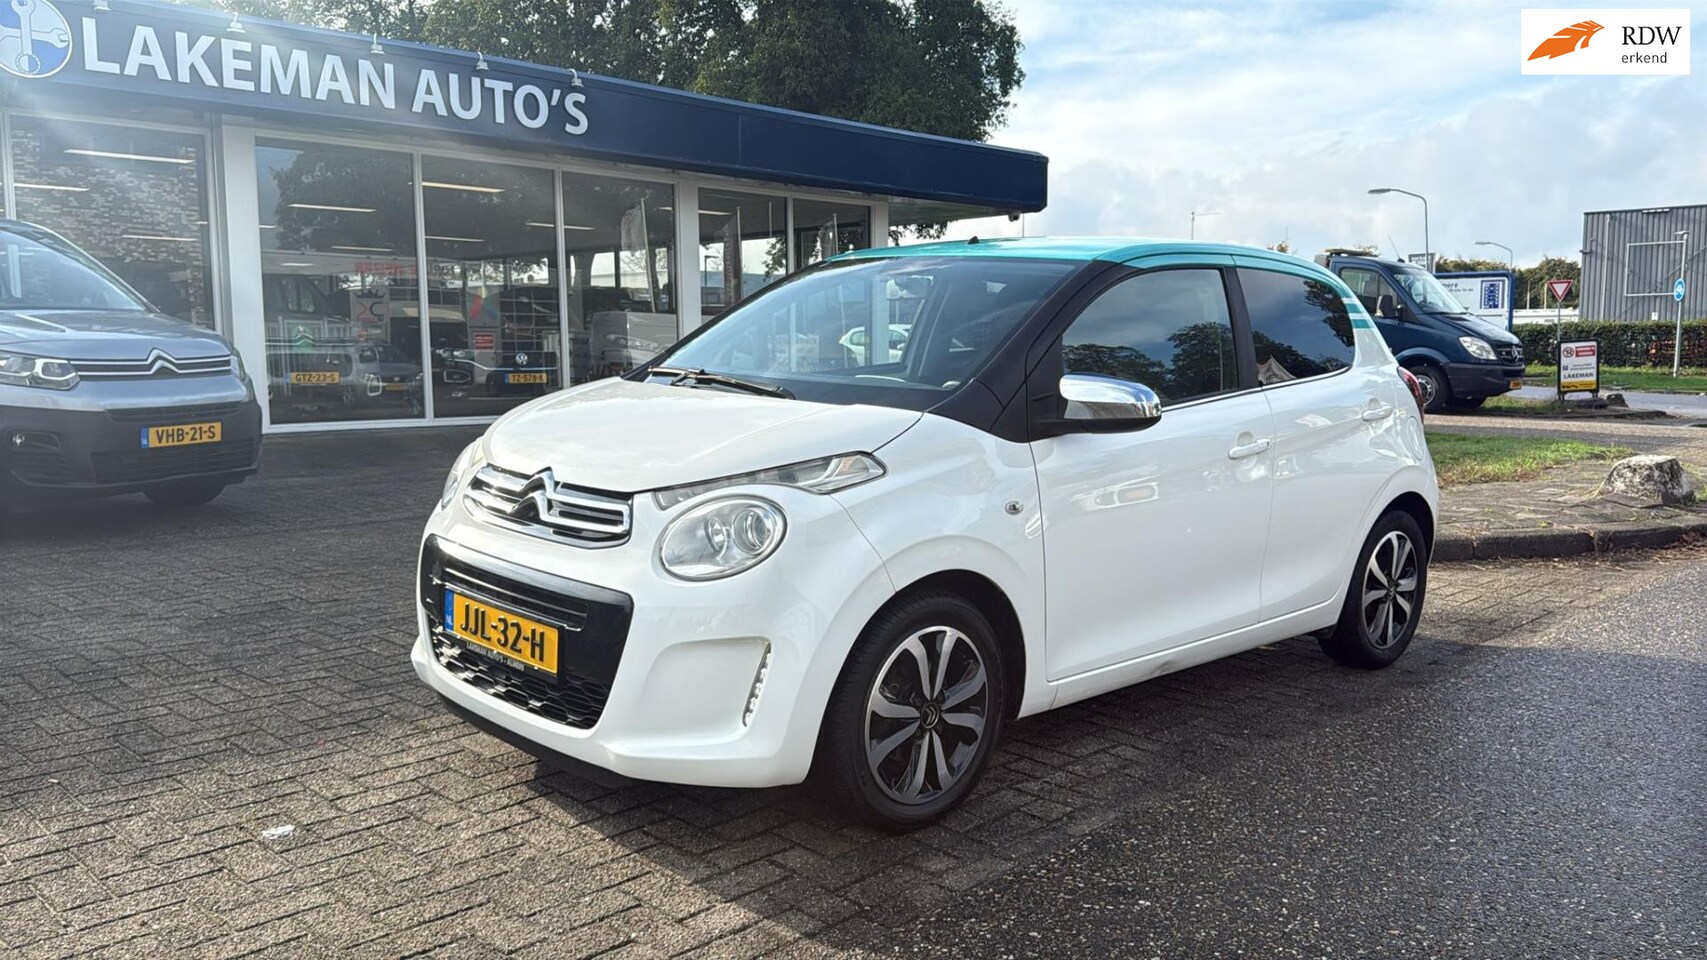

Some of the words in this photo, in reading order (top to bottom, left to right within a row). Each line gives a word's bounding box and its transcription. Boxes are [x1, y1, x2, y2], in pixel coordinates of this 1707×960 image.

[82, 17, 395, 109] LAKEMAN
[412, 69, 588, 135] AUTO'S
[155, 425, 216, 444] VHB-21-S
[460, 602, 545, 662] JJL-32-H
